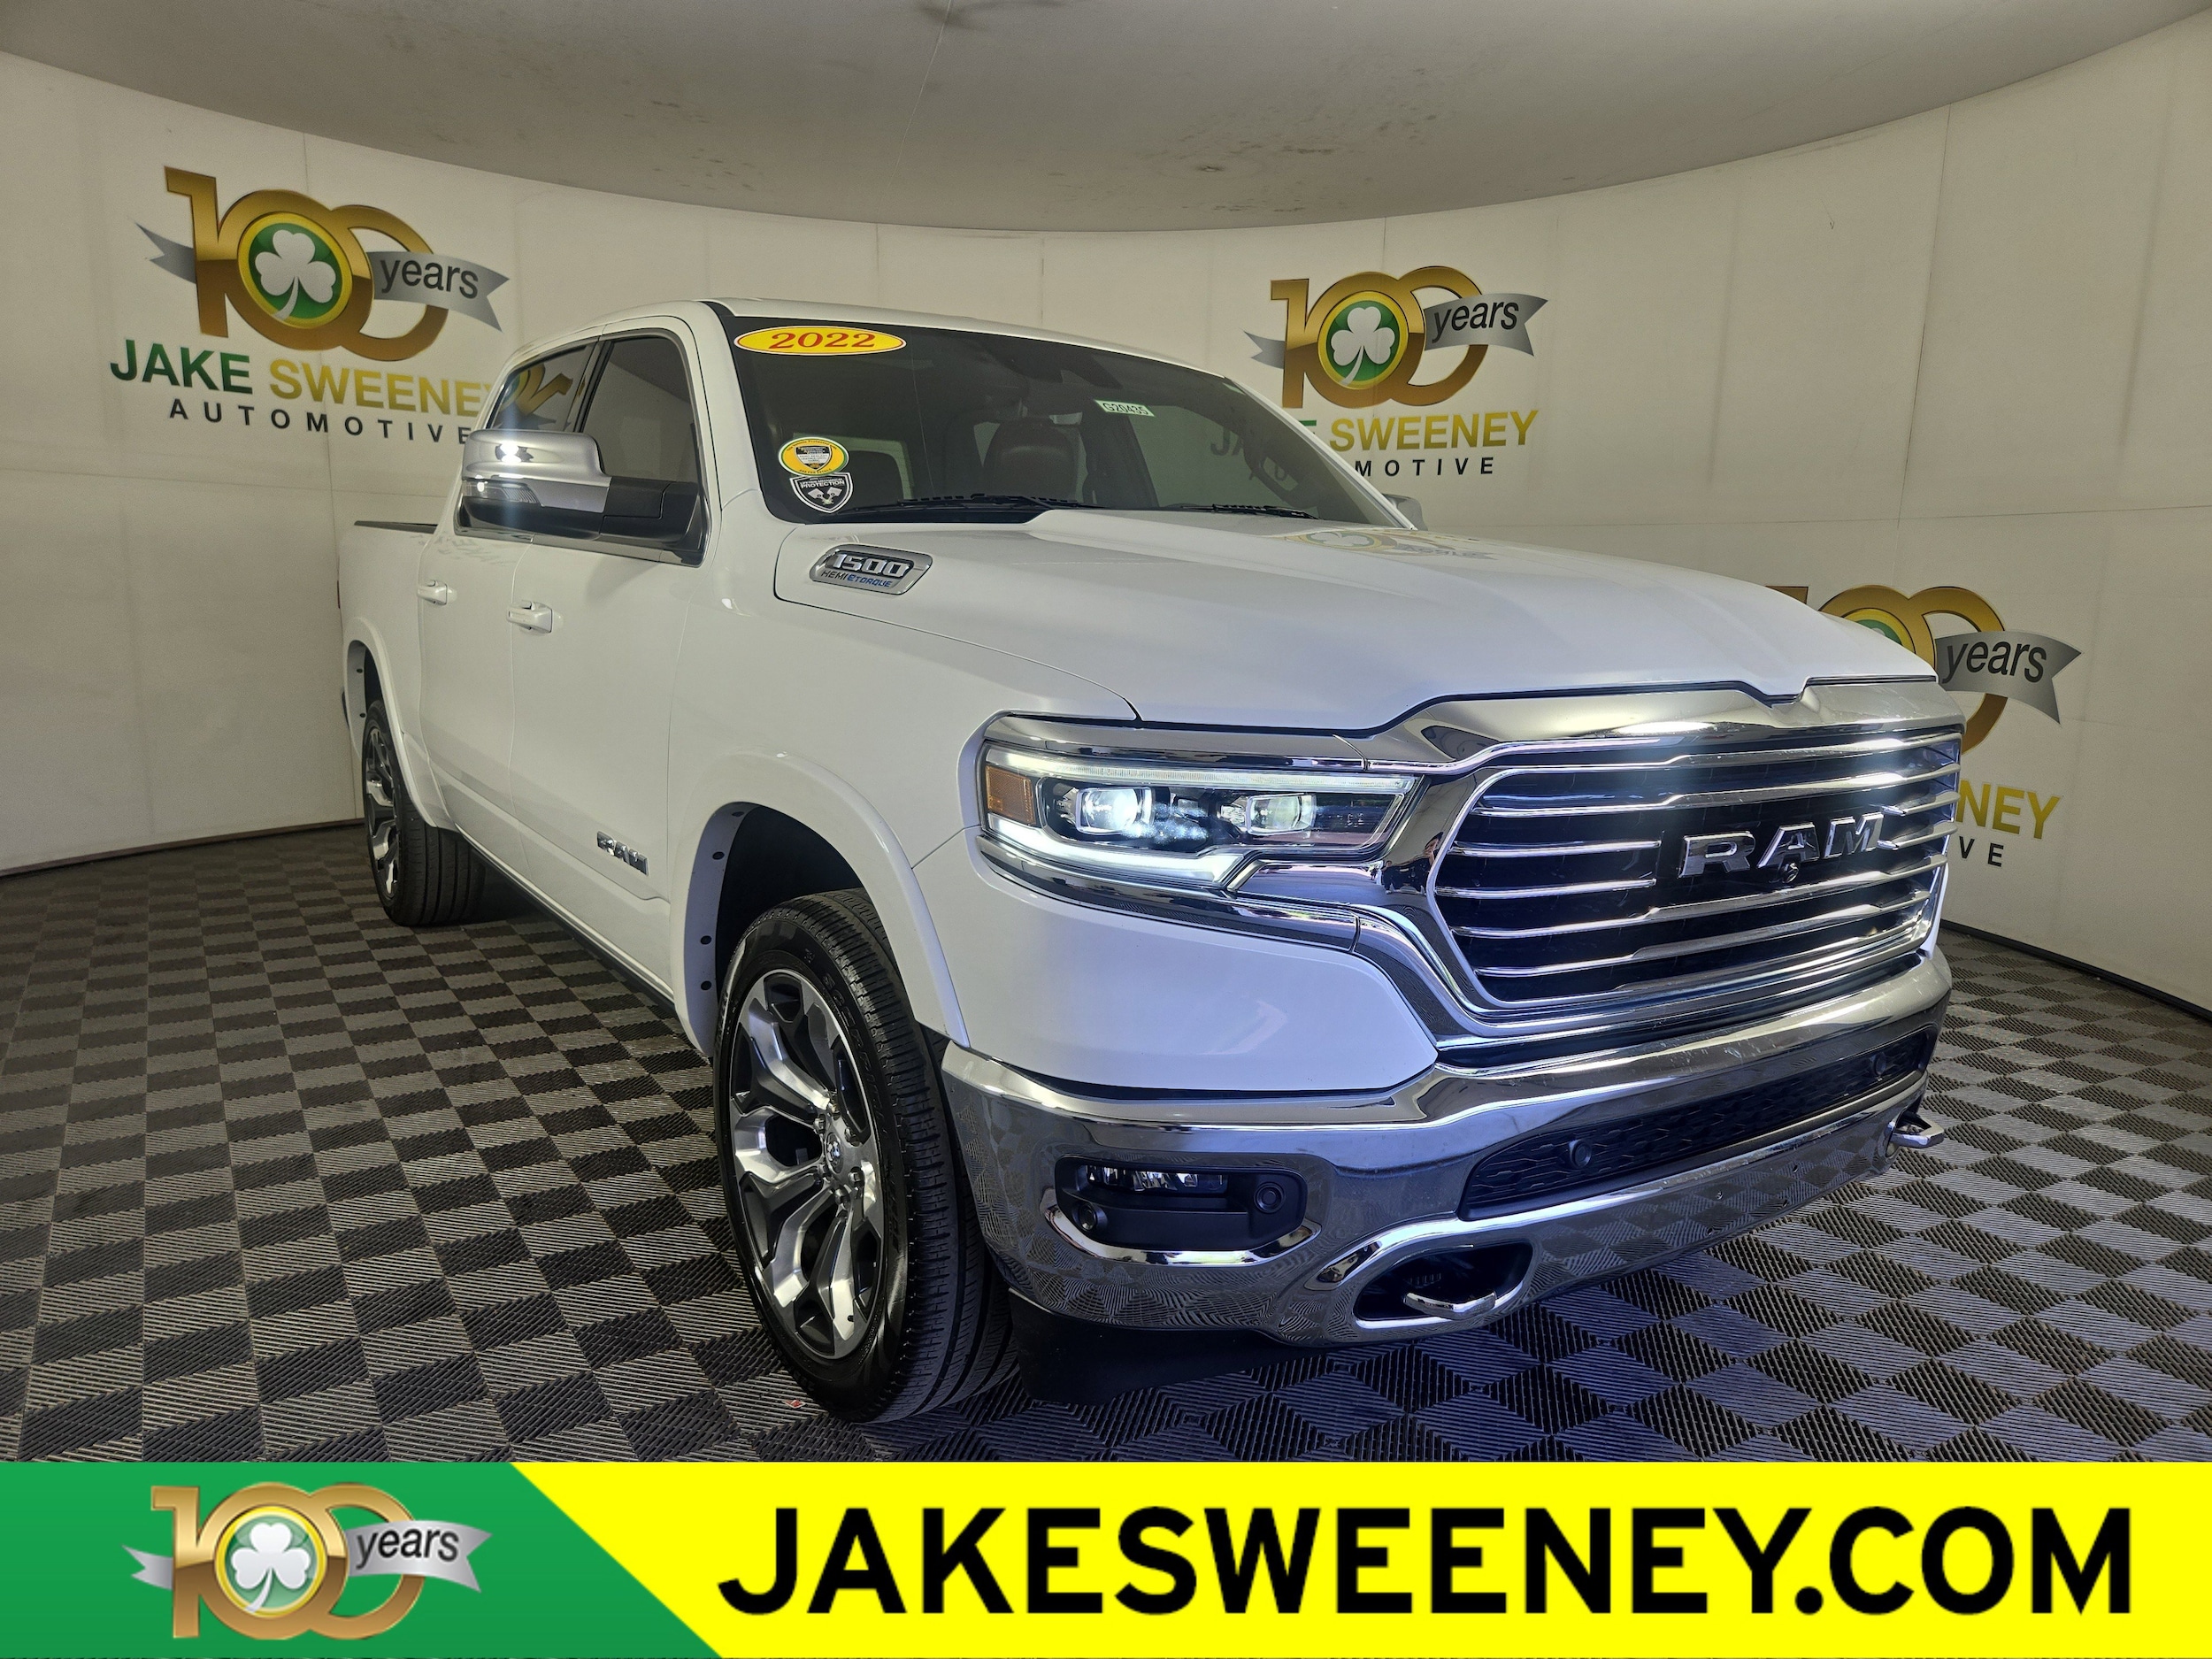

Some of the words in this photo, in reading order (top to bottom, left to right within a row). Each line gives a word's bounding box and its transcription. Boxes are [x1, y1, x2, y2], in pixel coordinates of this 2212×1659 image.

[164, 166, 449, 361] 100
[380, 258, 480, 300] years
[768, 333, 876, 349] 2022
[1271, 265, 1489, 409] 100
[1431, 301, 1520, 344] years
[110, 340, 254, 395] JAKE
[270, 359, 492, 418] SWEENE
[169, 398, 472, 445] AUTOMOTIVE
[1329, 410, 1540, 453] SWEENEY
[1355, 457, 1494, 478] MOTIVE
[821, 569, 847, 580] HEMI
[833, 553, 910, 578] 1500
[1941, 641, 2047, 683] years
[1678, 811, 1885, 879] RAM
